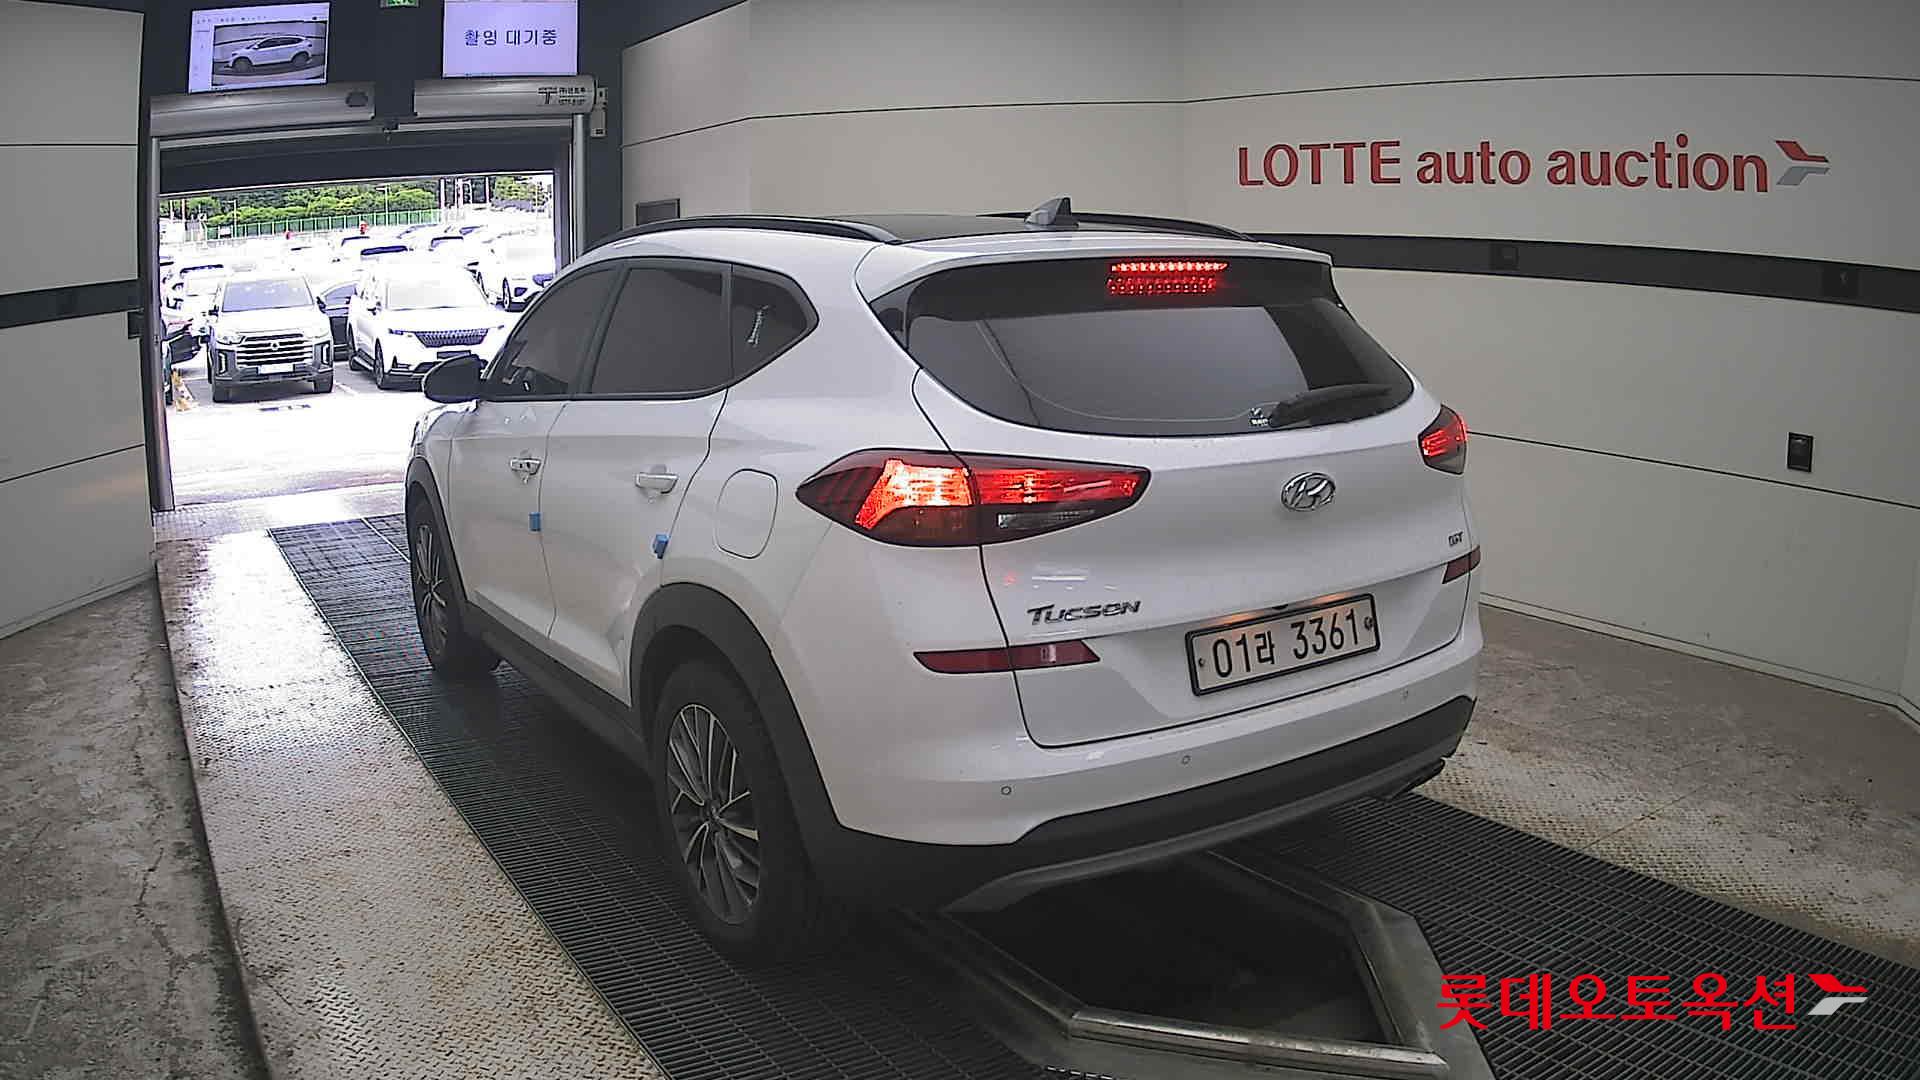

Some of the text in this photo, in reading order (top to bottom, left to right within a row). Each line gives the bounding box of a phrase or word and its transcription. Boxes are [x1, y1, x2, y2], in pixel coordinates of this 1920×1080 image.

[506, 29, 558, 46] 대기중
[1238, 134, 1768, 193] LOTTE auto auction
[1213, 608, 1359, 678] 01라 3361
